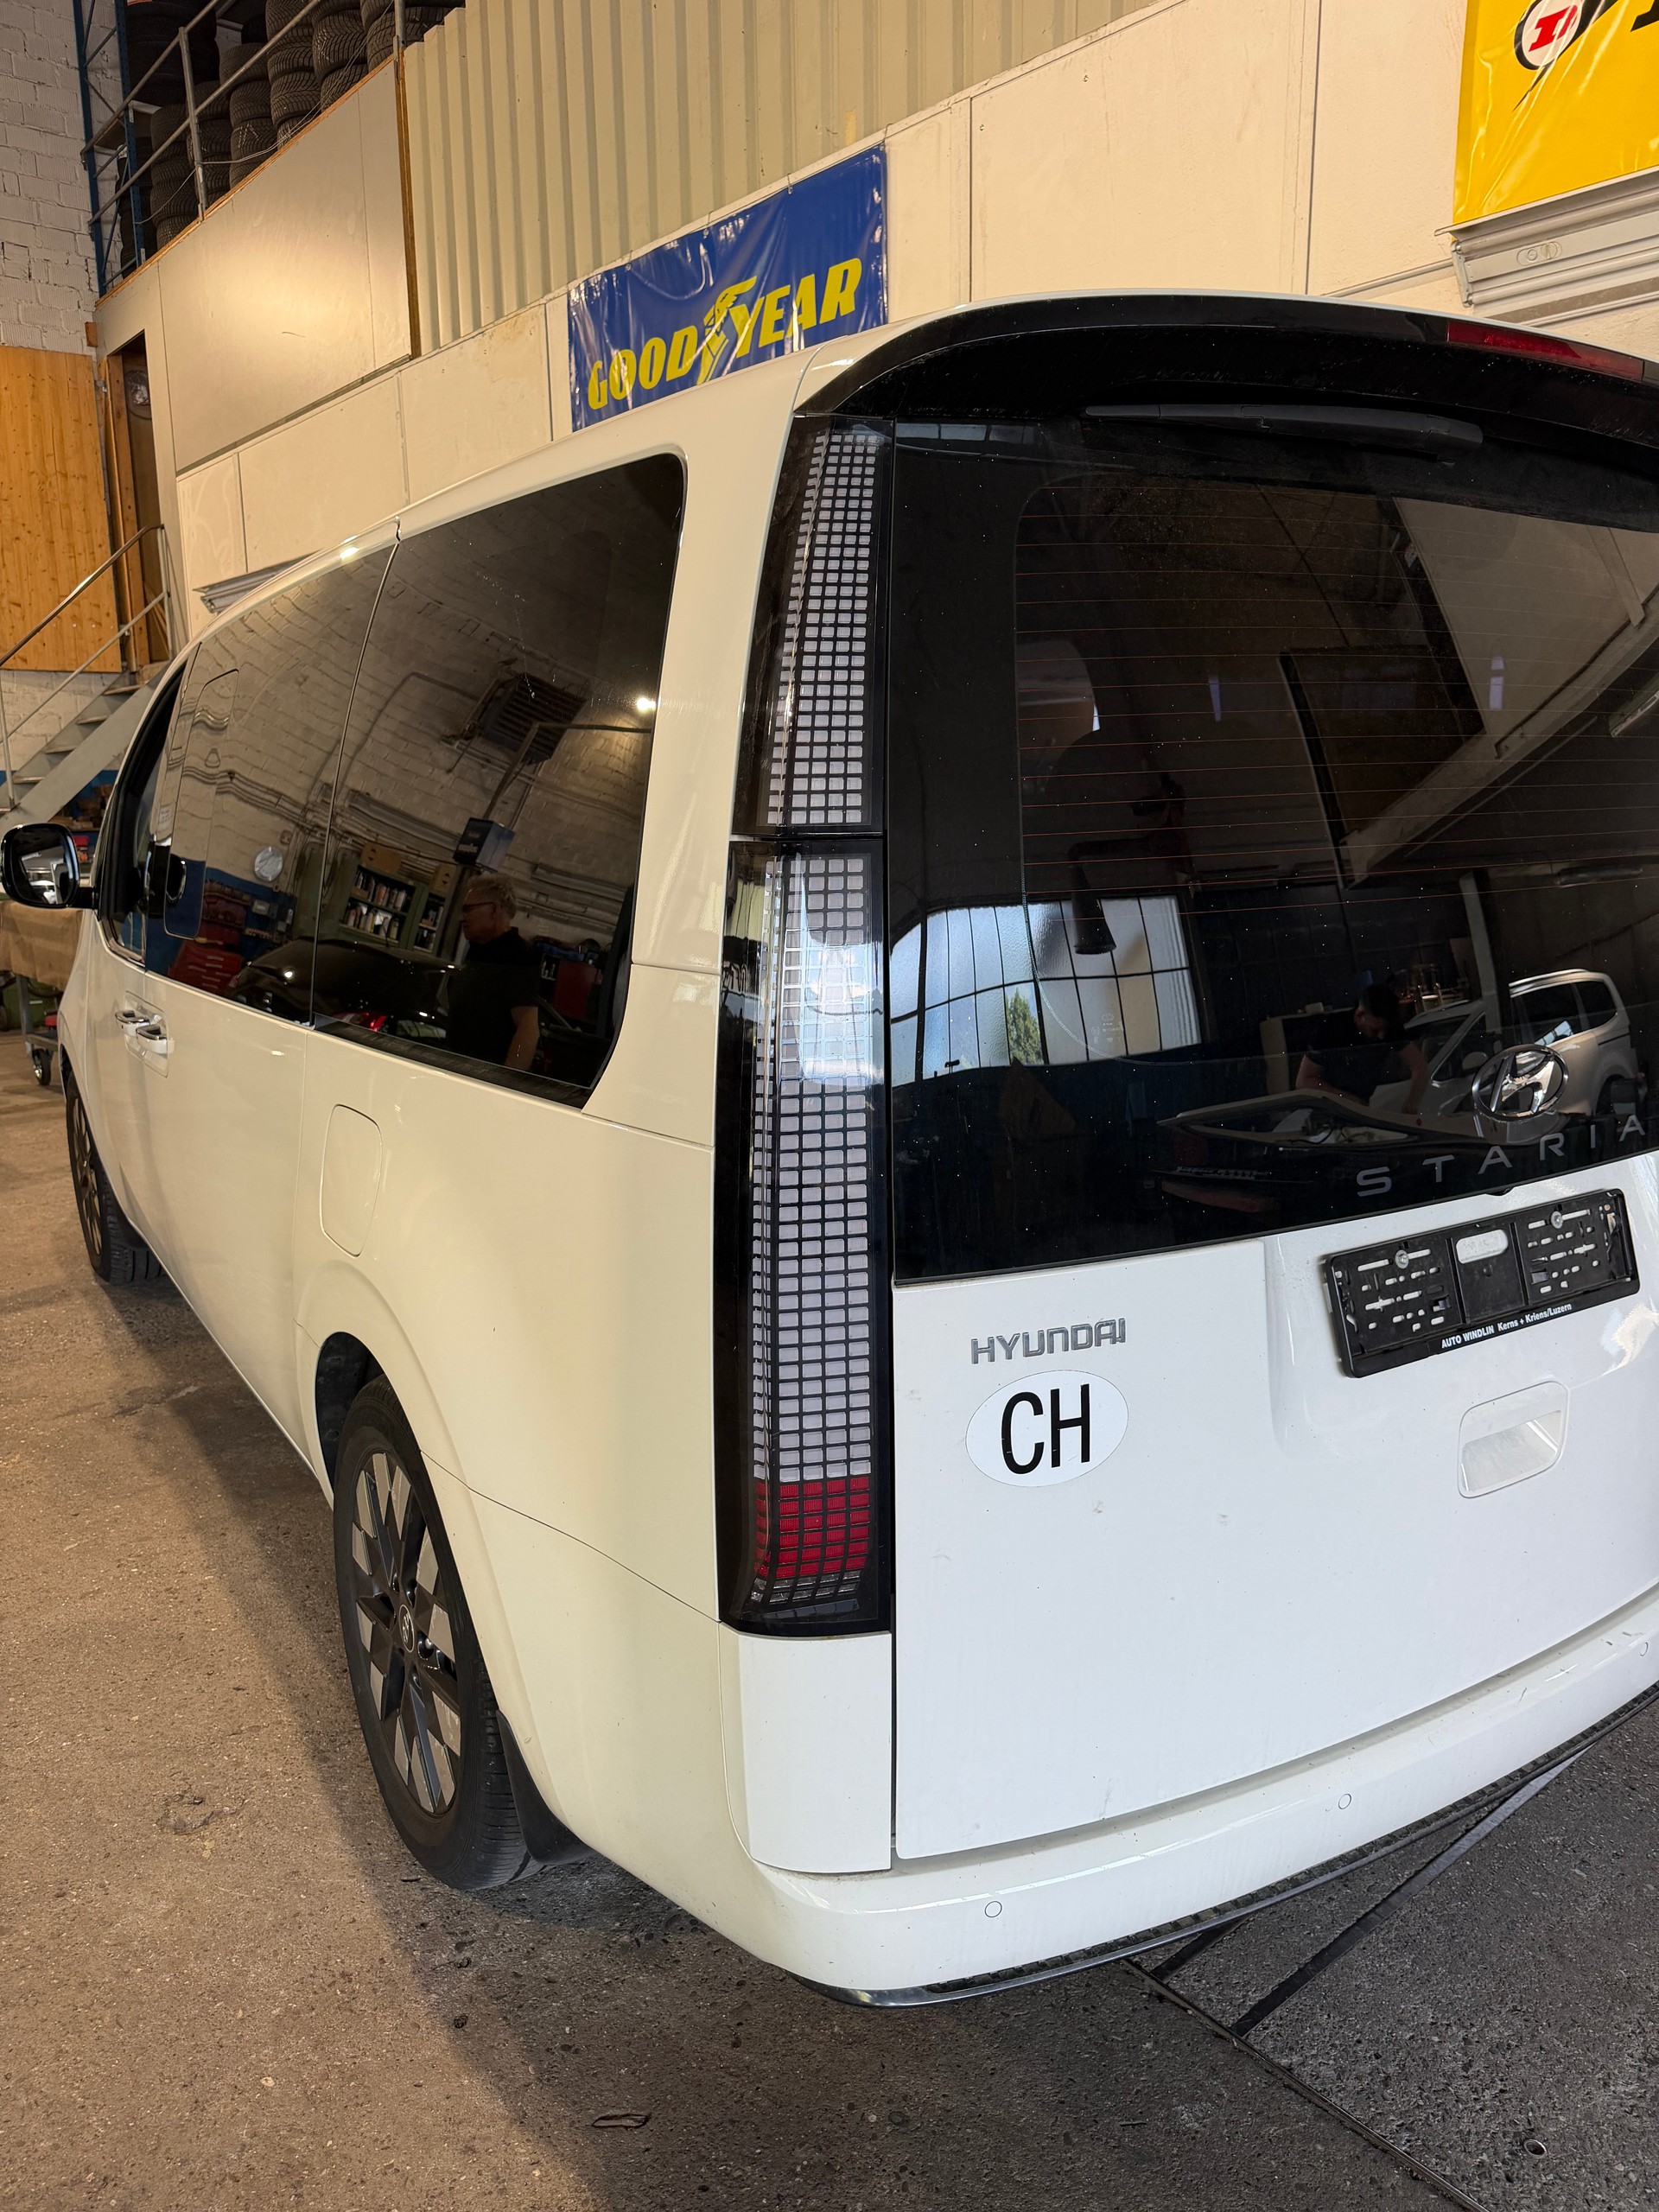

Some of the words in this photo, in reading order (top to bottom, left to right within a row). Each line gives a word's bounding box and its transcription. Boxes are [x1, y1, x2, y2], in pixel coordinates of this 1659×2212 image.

[588, 257, 863, 410] GOODYEAR
[1357, 1115, 1645, 1197] STARIA
[970, 1318, 1126, 1364] HYUNDAI
[1441, 1335, 1461, 1348] AUTO
[1462, 1325, 1494, 1342] WINDLIN
[1497, 1319, 1518, 1332] Kerns
[1525, 1303, 1572, 1323] Kriens/Luzern
[1001, 1383, 1090, 1475] CH
